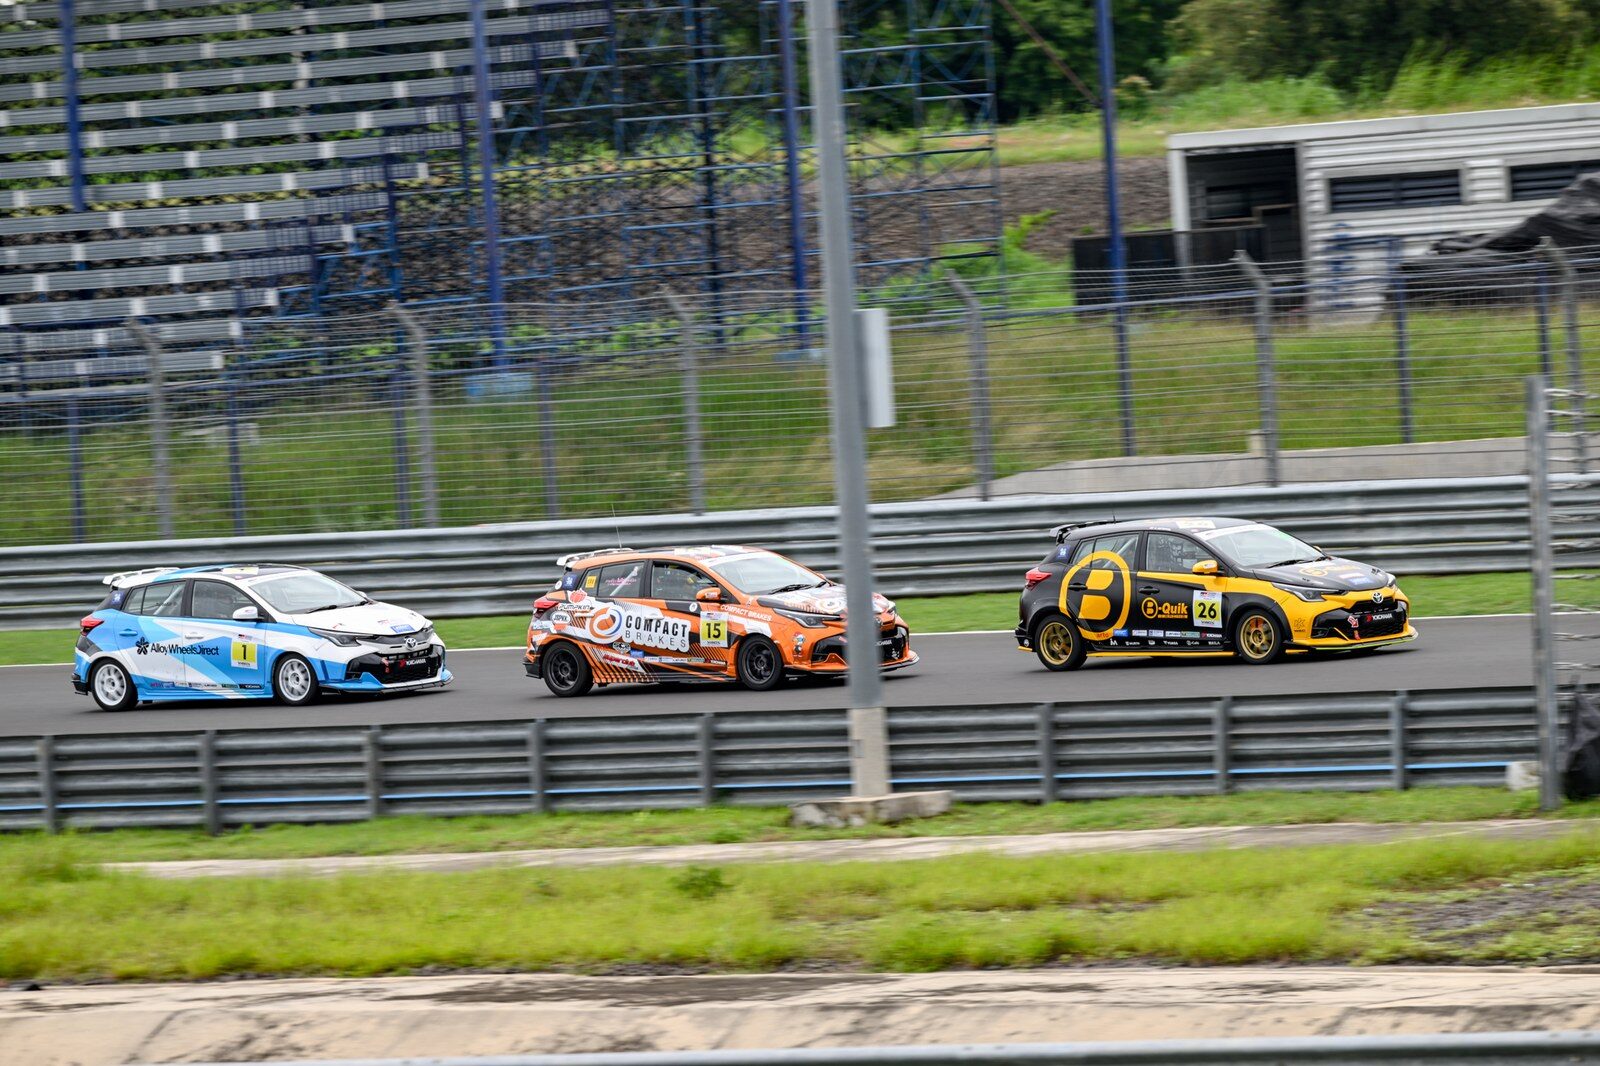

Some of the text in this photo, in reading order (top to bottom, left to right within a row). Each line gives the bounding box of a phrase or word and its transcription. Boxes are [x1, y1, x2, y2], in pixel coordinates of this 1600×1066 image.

[721, 604, 748, 616] COMPACT
[747, 610, 772, 622] BRAKES
[1198, 602, 1217, 619] 26
[625, 614, 688, 638] COMPACT
[706, 622, 721, 639] 15
[625, 630, 686, 648] BRAKES
[241, 644, 247, 660] 1
